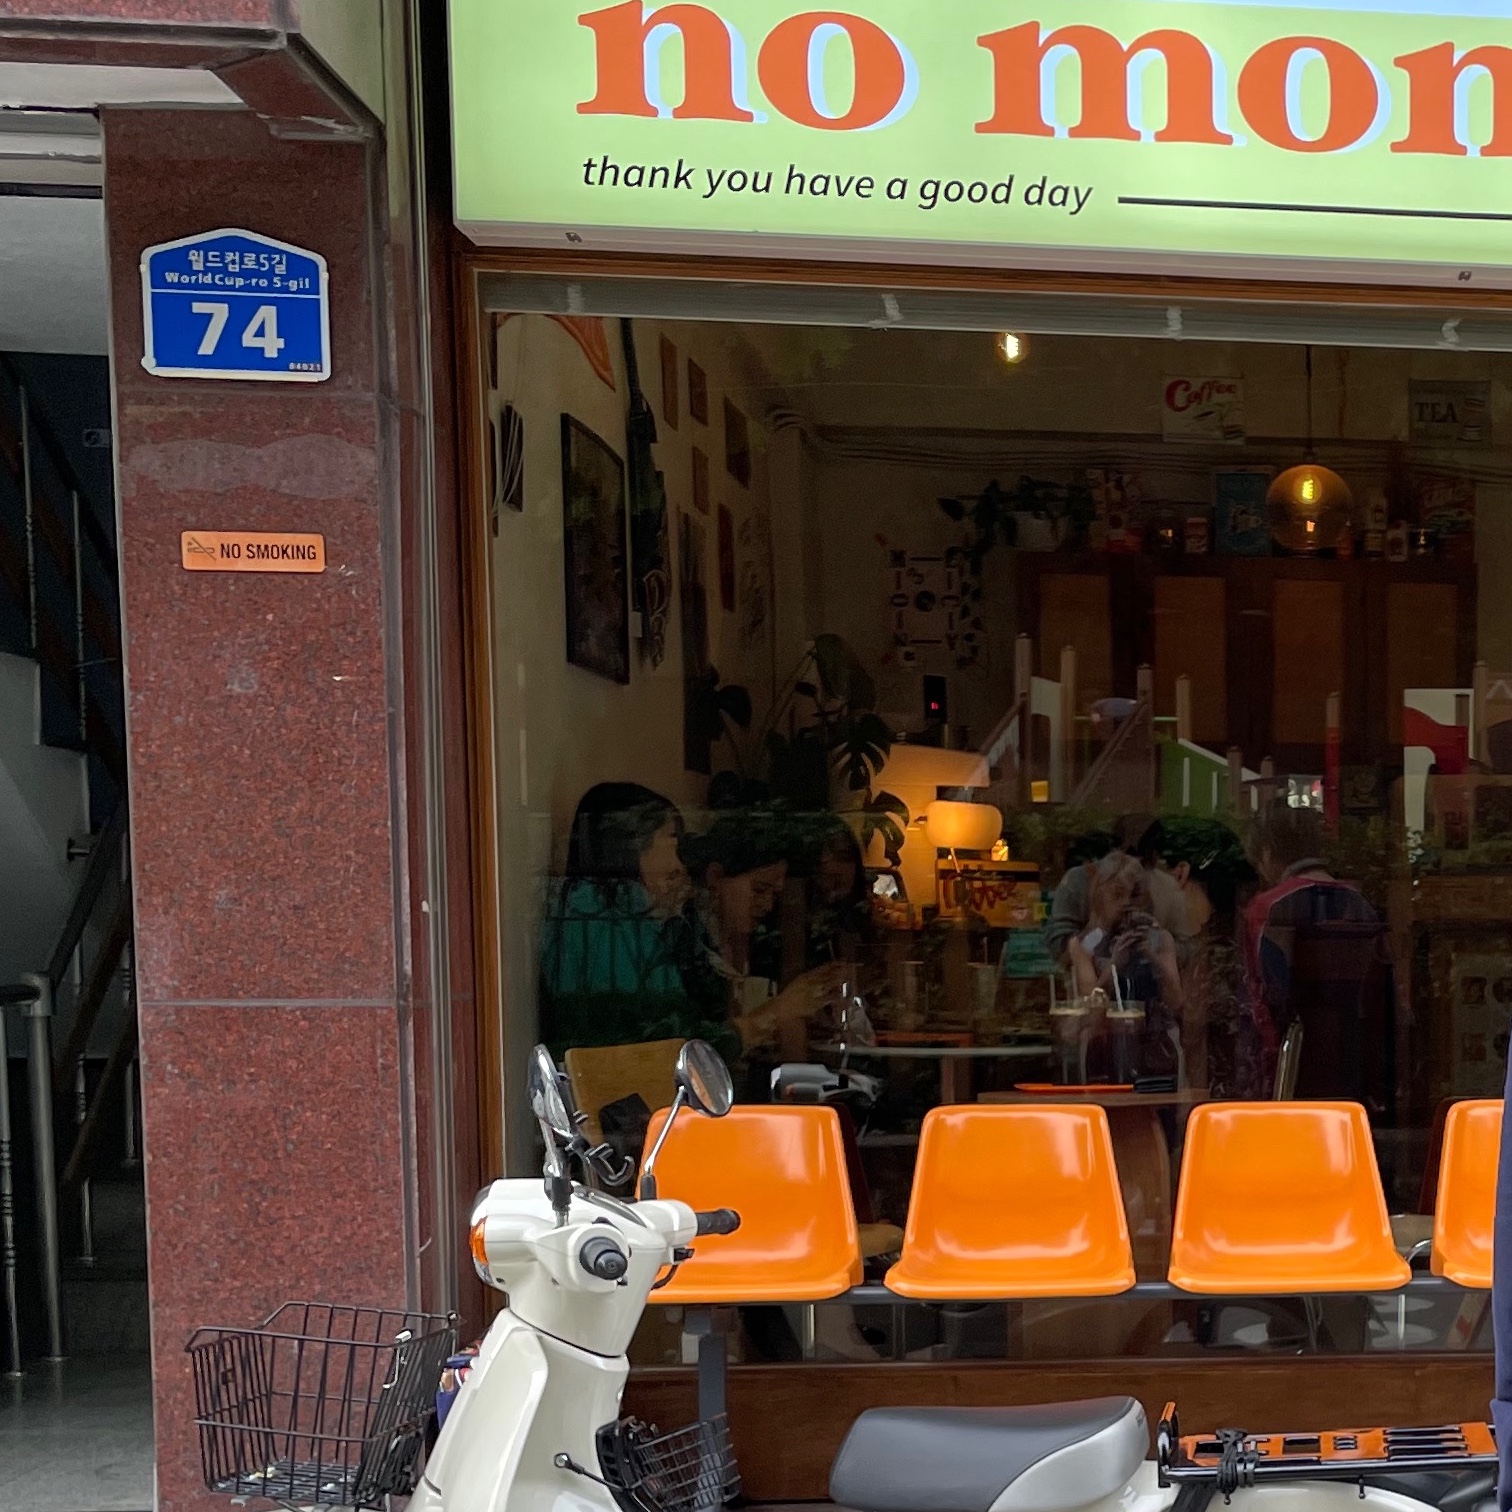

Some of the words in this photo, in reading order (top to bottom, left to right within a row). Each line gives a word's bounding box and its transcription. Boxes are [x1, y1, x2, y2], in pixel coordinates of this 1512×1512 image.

[576, 0, 910, 131] no
[582, 154, 695, 191] thank
[702, 163, 771, 199] you
[785, 163, 874, 200] have
[885, 176, 908, 201] a
[918, 174, 1014, 210] good
[1022, 176, 1093, 216] day
[188, 250, 286, 274] 월드컵로5길
[273, 277, 309, 291] 5-gil
[192, 302, 285, 358] 74
[1415, 401, 1460, 424] TEA
[219, 541, 242, 562] NO
[245, 542, 317, 564] SMOKING
